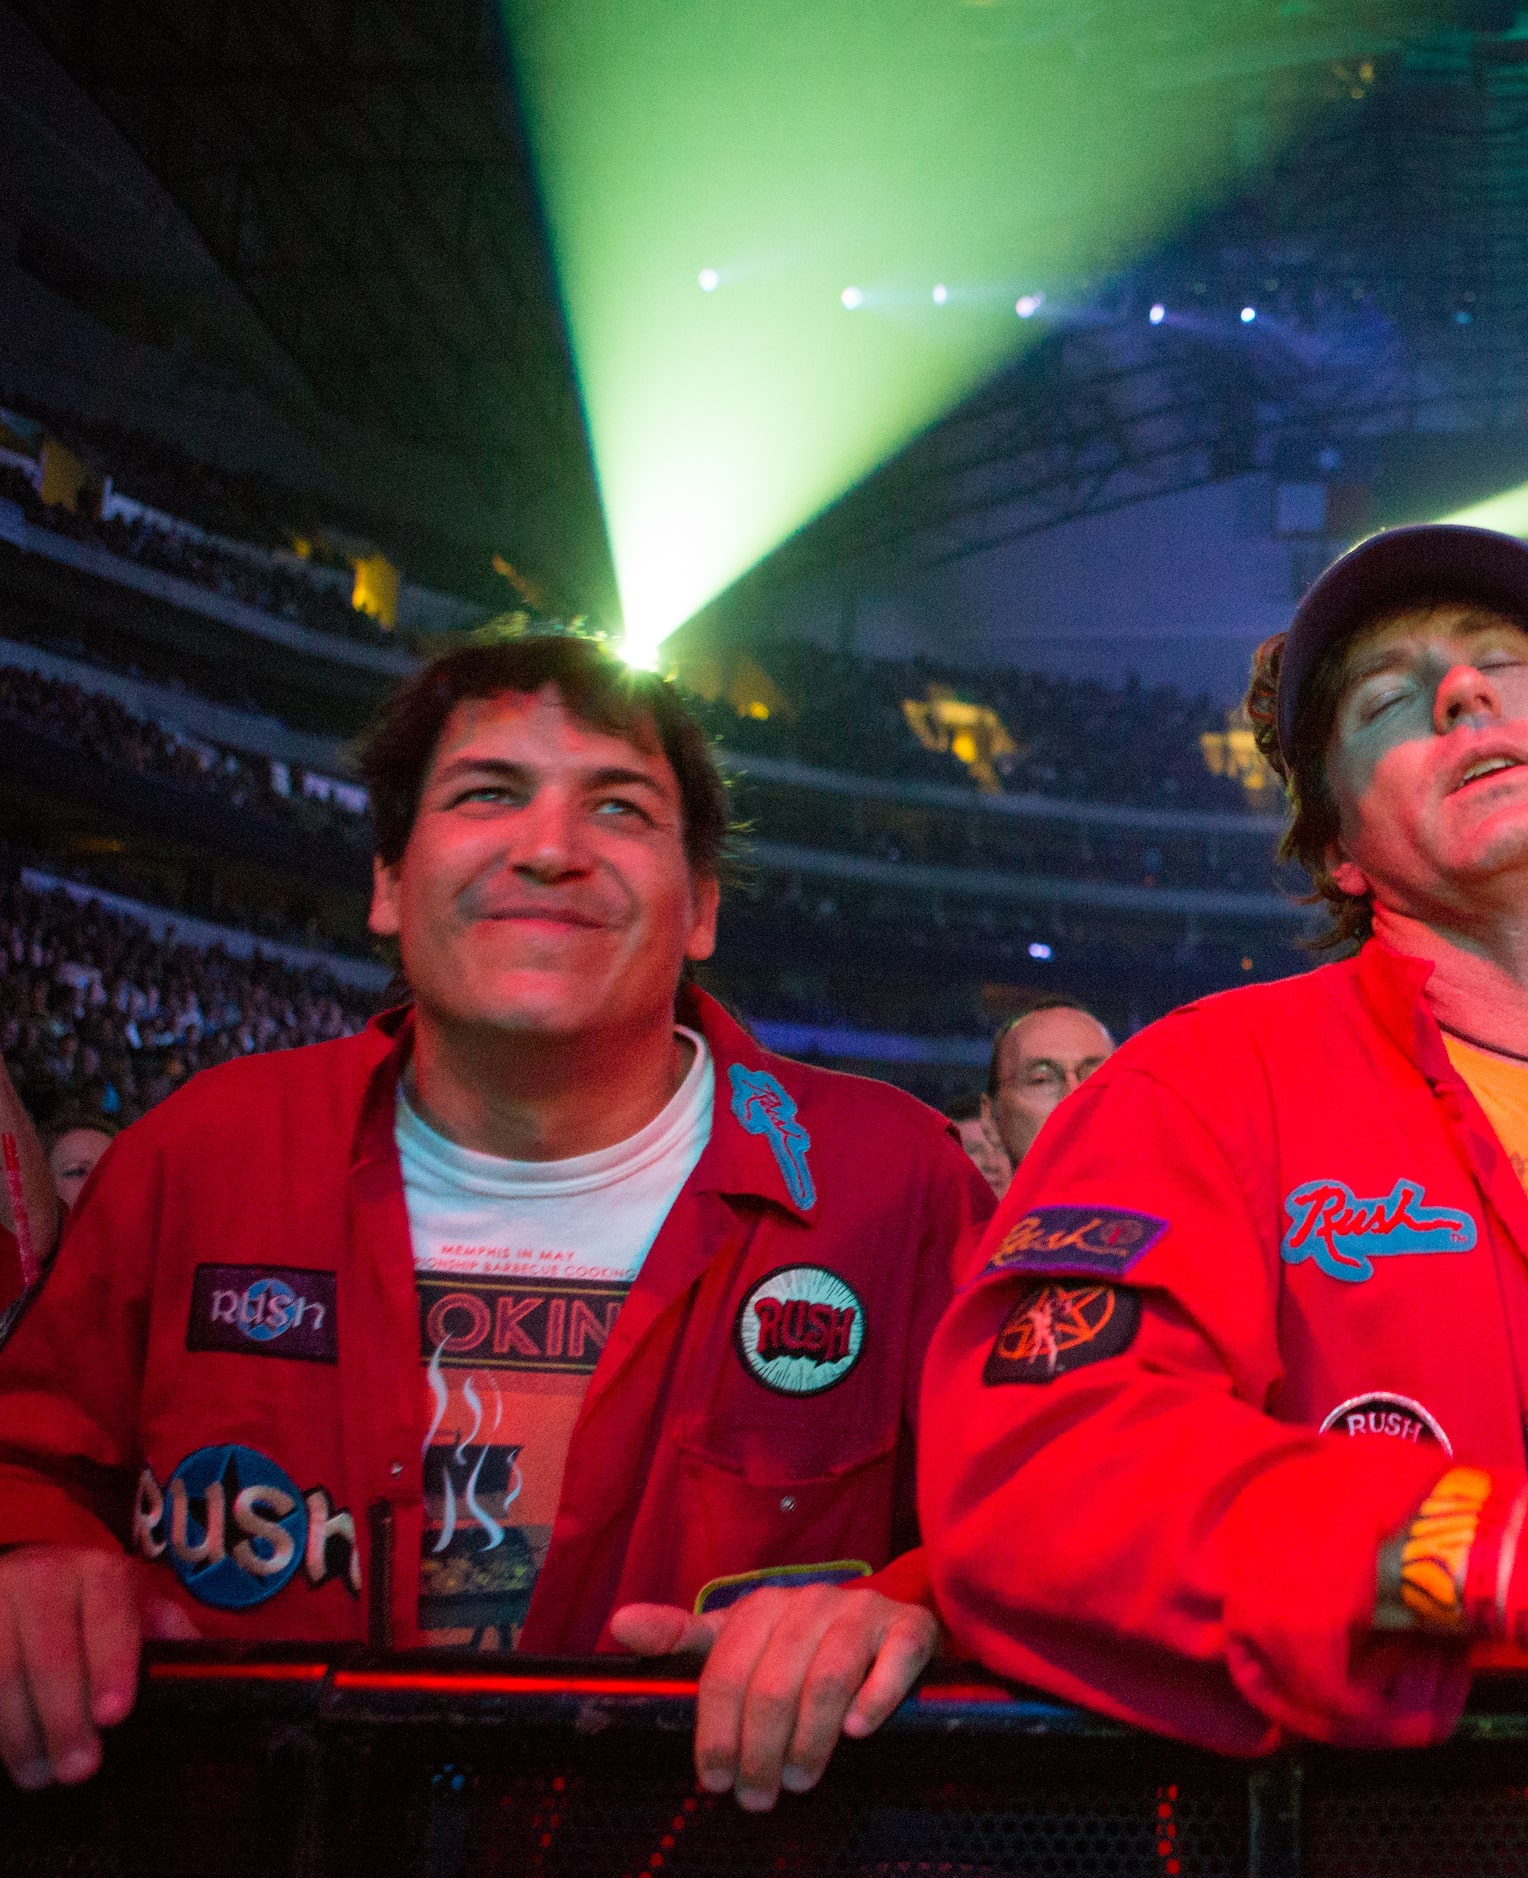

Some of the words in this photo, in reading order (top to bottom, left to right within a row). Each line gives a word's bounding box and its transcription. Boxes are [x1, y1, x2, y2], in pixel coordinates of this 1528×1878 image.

[1288, 1185, 1463, 1268] Rush
[441, 1244, 510, 1259] MEMPHIS
[516, 1247, 533, 1259] IN
[539, 1250, 575, 1261] MAY
[483, 1261, 558, 1276] BARBECUE
[563, 1265, 636, 1279] COOKING
[754, 1297, 856, 1361] RUSH
[1346, 1411, 1423, 1443] RUSH
